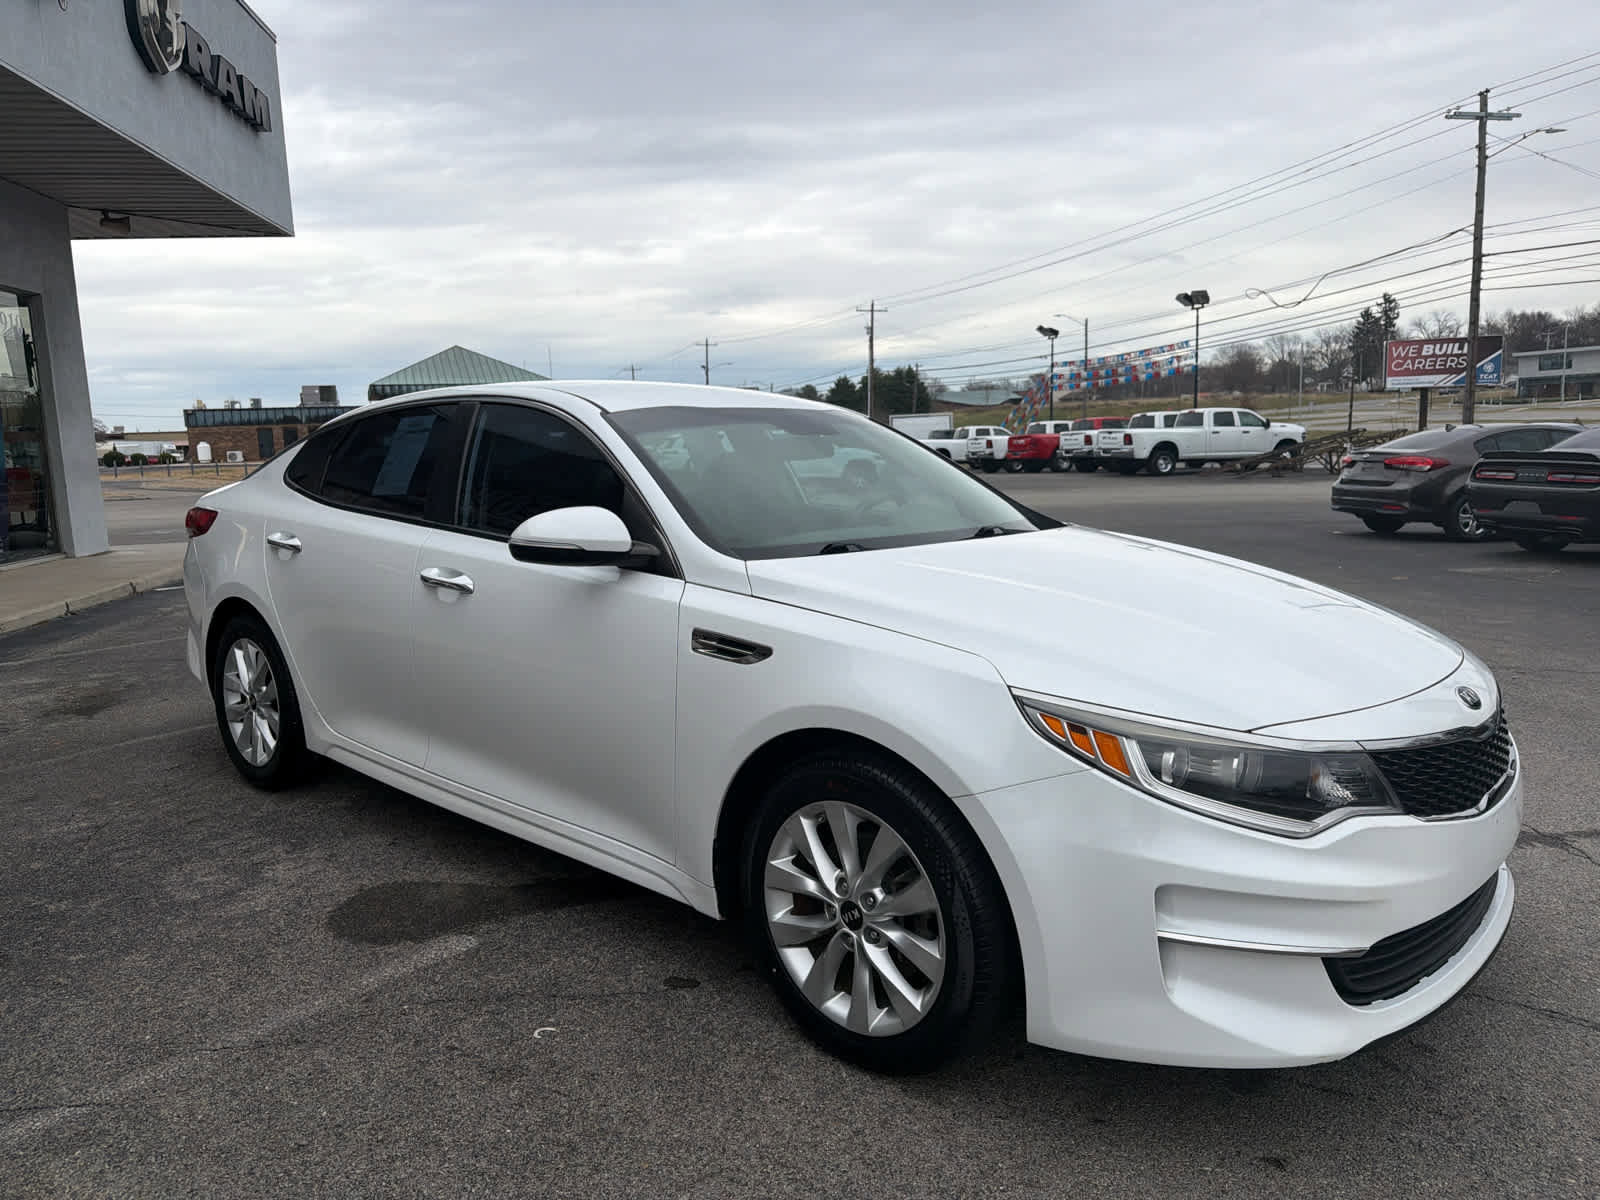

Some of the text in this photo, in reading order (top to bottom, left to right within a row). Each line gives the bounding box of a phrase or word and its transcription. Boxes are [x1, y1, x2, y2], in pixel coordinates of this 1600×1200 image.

[181, 21, 271, 132] RAM
[1392, 345, 1418, 357] WE
[1392, 356, 1467, 371] CAREERS
[842, 909, 860, 923] KIA
